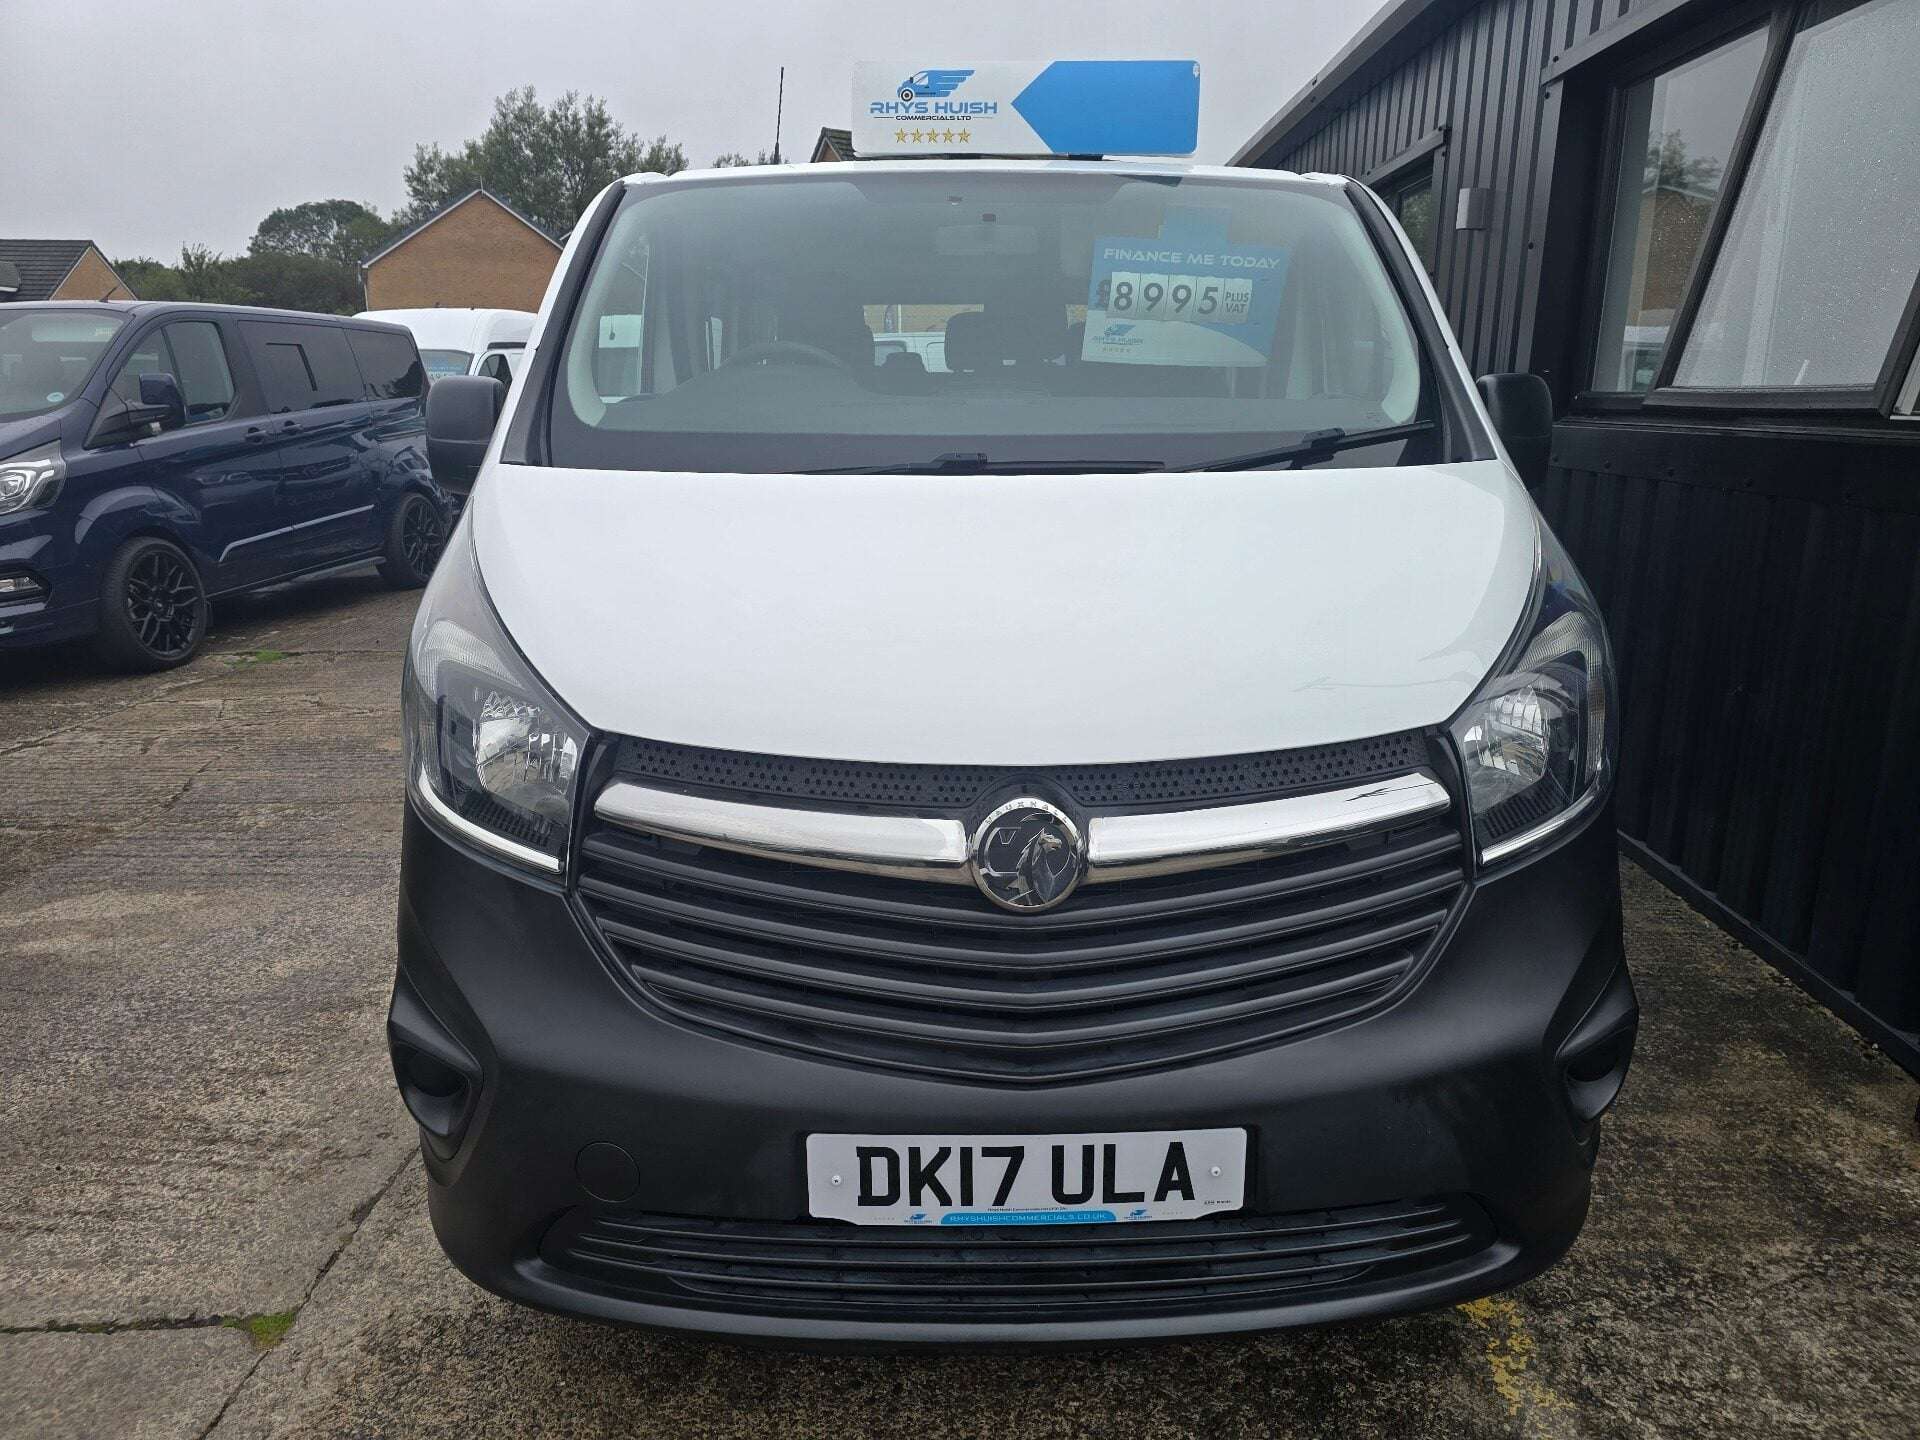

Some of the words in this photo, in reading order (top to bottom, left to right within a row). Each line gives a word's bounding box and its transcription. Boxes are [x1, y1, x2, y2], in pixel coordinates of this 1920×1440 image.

[870, 101, 929, 115] RHYS
[934, 101, 998, 115] HUISH
[1103, 248, 1183, 264] FINANCE
[1186, 252, 1215, 266] ME
[1220, 255, 1280, 269] TODAY
[1224, 291, 1250, 303] PLUS
[1225, 302, 1247, 314] VAT
[856, 1145, 1025, 1207] DK17
[1051, 1141, 1195, 1206] ULA
